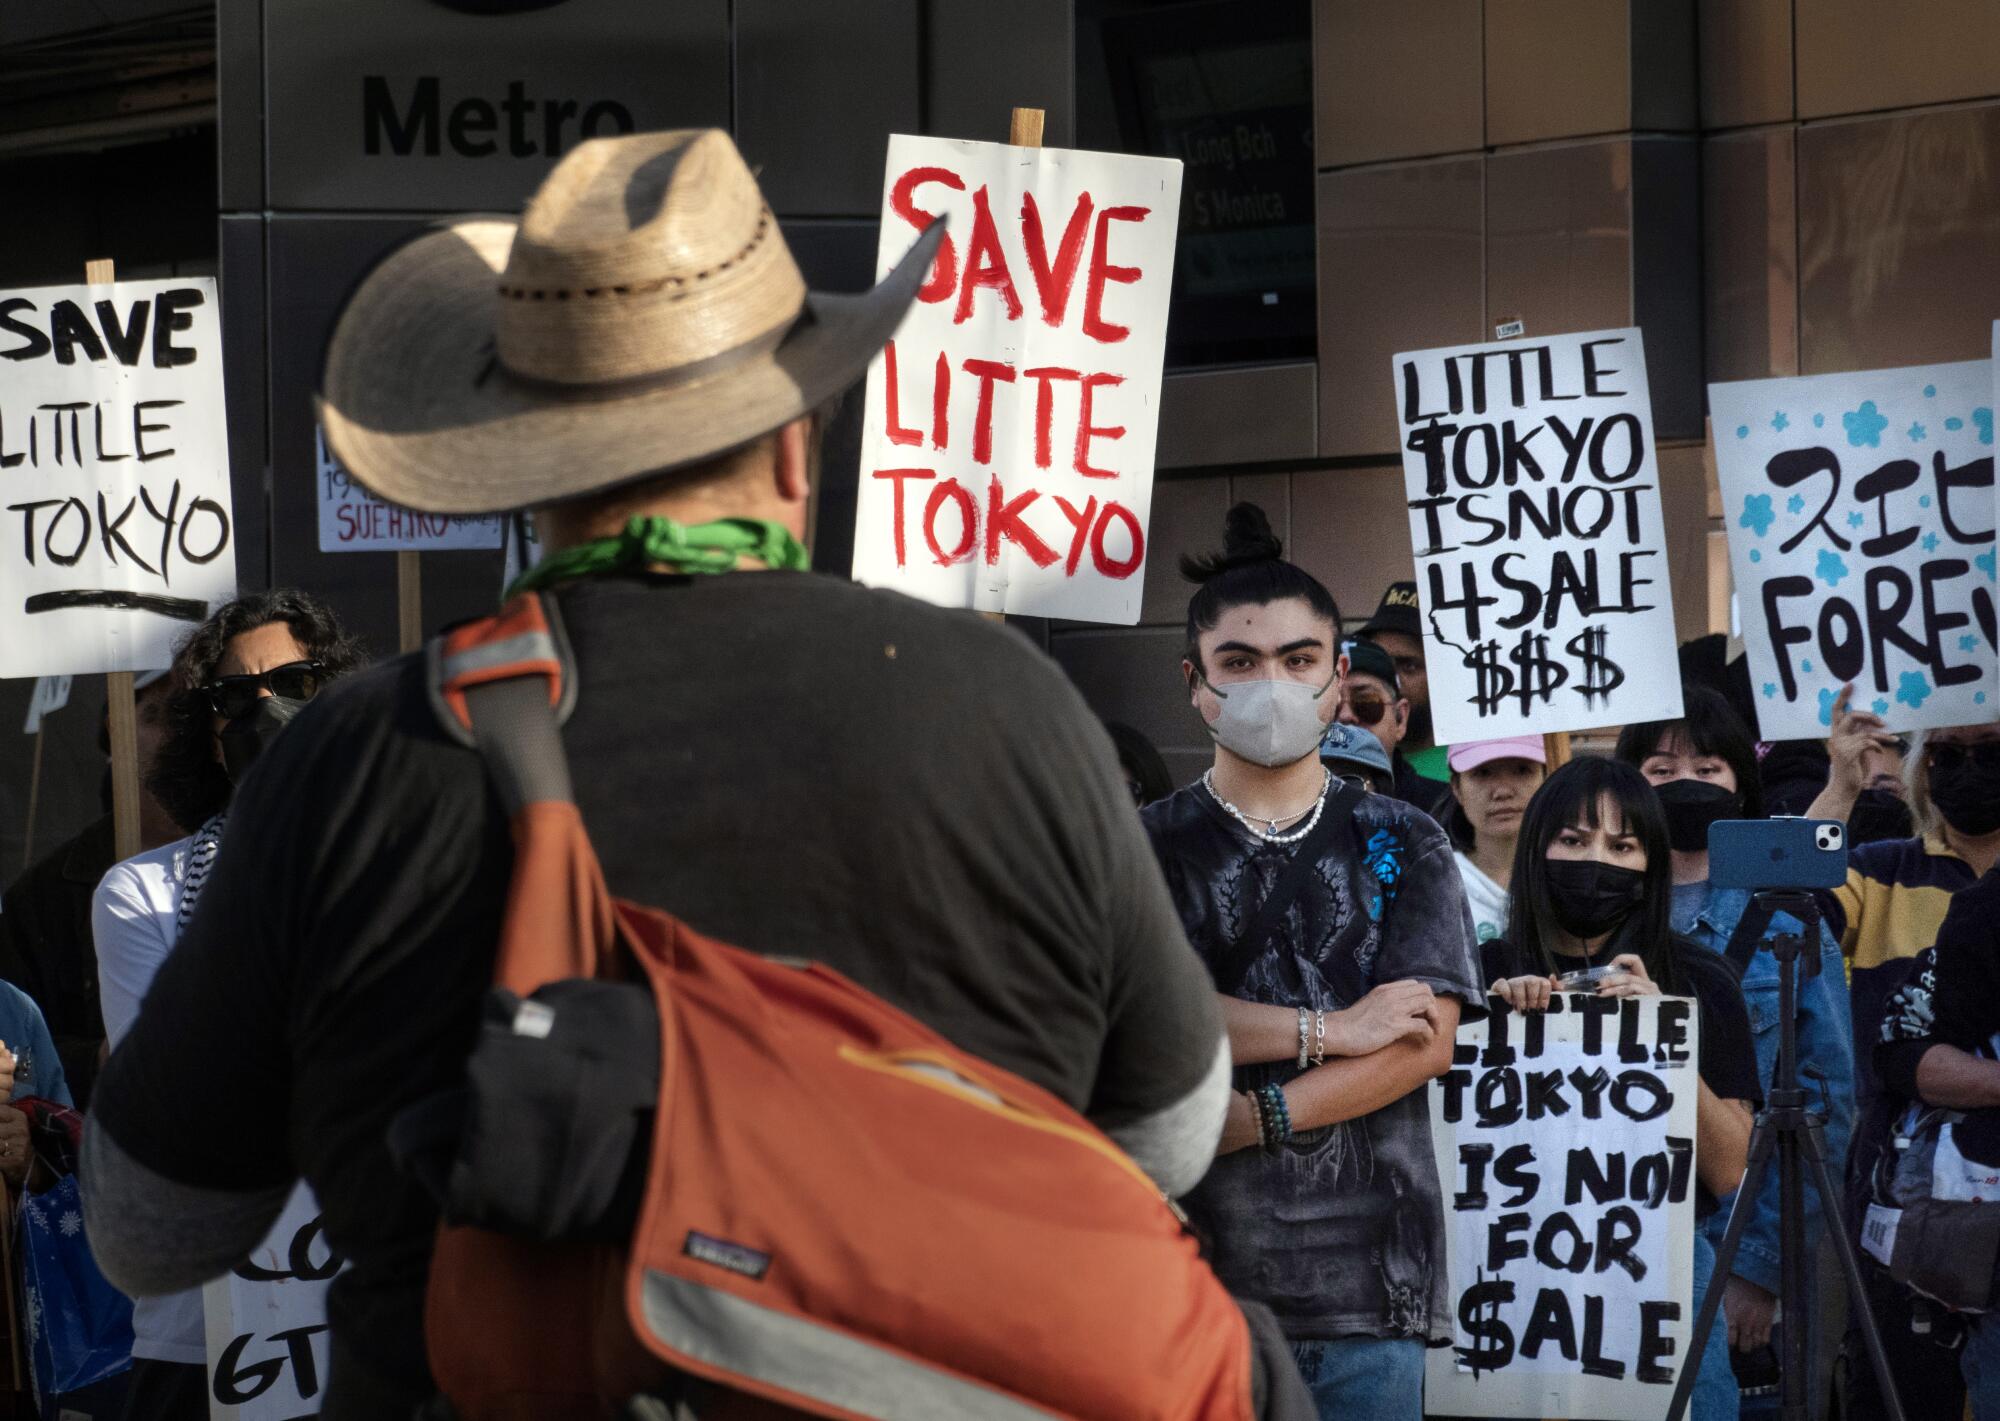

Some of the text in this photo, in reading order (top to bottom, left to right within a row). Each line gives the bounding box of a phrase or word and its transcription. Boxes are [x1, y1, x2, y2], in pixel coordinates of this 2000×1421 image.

[363, 76, 635, 158] Metro
[889, 167, 1151, 343] SAVE
[0, 288, 205, 368] SAVE
[885, 340, 1127, 479] LITTE
[1403, 338, 1628, 424] LITTLE
[1406, 413, 1645, 496] TOKYO
[6, 478, 229, 588] TOKYO
[872, 468, 1145, 580] TOKYO
[1463, 624, 1626, 718] $$$
[1436, 1065, 1674, 1128] TOKYO
[1453, 1135, 1693, 1212] IS NOT
[1487, 1205, 1648, 1283] FOR
[1452, 1264, 1682, 1385] $ALE
